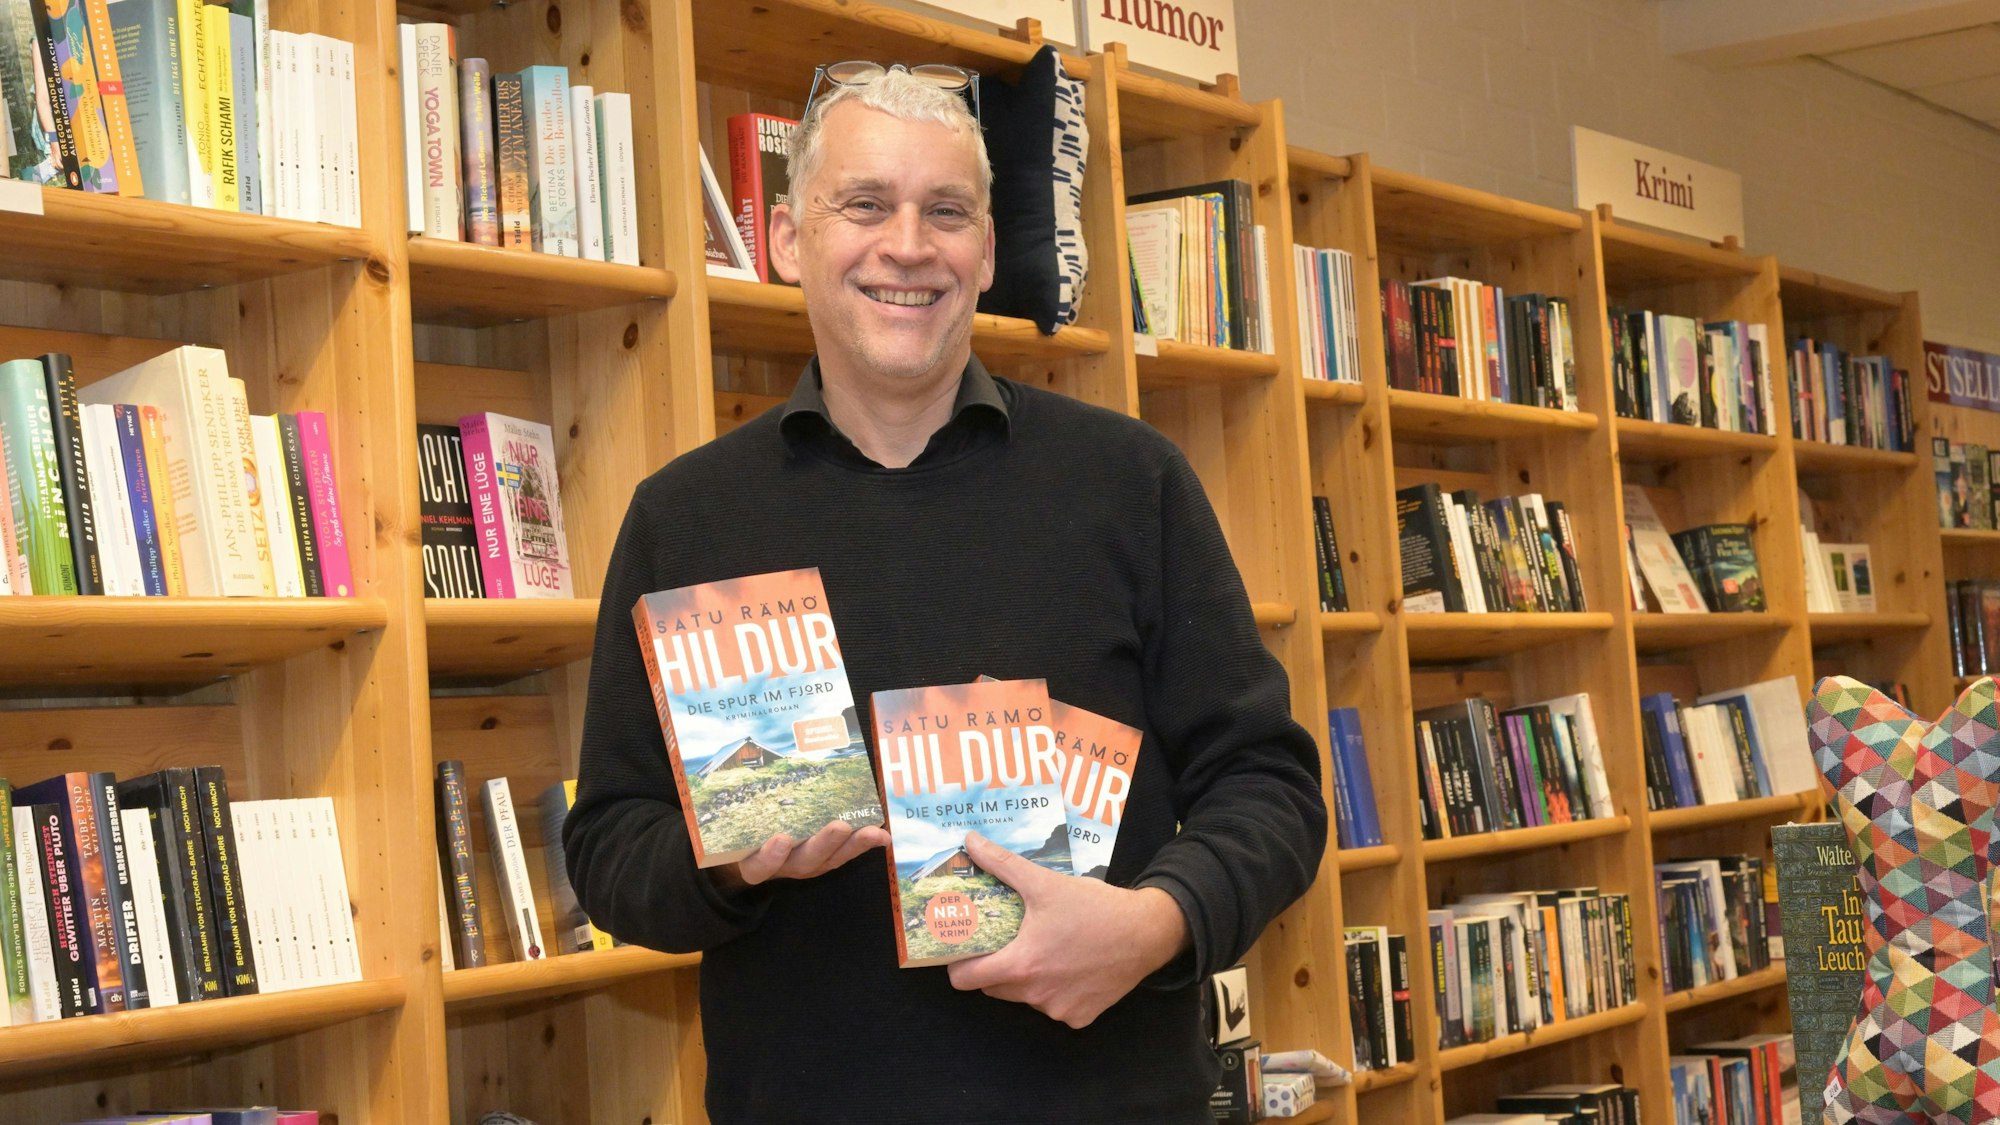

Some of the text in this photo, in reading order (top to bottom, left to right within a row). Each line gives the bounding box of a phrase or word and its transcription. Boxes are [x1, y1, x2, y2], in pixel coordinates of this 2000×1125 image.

[168, 16, 182, 96] DIE TAGE OHNE DICH
[193, 0, 207, 91] ECHTZEITALTE
[417, 38, 430, 75] SPECK
[429, 35, 443, 77] DANIEL
[47, 76, 70, 157] GREGOR SANDER
[48, 37, 78, 156] ALLES RICHTIG GEMACHT
[217, 95, 233, 138] SCHAMI
[509, 80, 522, 132] ANFANG
[196, 120, 206, 158] TONIO
[424, 86, 444, 188] YOGA TOWN
[496, 80, 514, 163] VON HIER BIS
[542, 99, 555, 166] Die Kinder
[553, 74, 567, 166] von Beauvallon
[585, 125, 594, 155] Paradise
[221, 140, 236, 186] RAFIK
[758, 135, 788, 155] ROSE
[244, 175, 252, 203] PIPER
[547, 168, 559, 212] BETTINA
[557, 167, 568, 207] STORKS
[1634, 158, 1695, 210] Krimi
[434, 205, 442, 234] FISCHER
[741, 198, 757, 265] OSENFELDT
[60, 379, 71, 417] BITTE
[126, 415, 135, 437] HEYNE
[231, 396, 250, 454] VOR DER
[504, 423, 540, 440] Malin Stehn
[135, 447, 149, 503] Herzenhören
[198, 367, 242, 560] JAN-PHILIPP SENDKER
[217, 392, 249, 534] DIE BURMA TRILOGIE
[284, 424, 302, 487] SCHICKSAL
[417, 434, 470, 504] ICHT
[508, 440, 539, 467] NUR
[72, 436, 94, 542] DAVID SEDARIS
[308, 449, 326, 506] SHIPMAN
[140, 507, 154, 546] Sendker
[421, 515, 473, 526] NIEL KEHLMAN
[473, 451, 501, 559] NUR EINE LÜGE
[514, 495, 550, 522] EINE
[249, 509, 271, 563] SETZ
[297, 495, 314, 562] ZERUYA SHALEV
[317, 511, 331, 548] VIOLA
[62, 563, 75, 591] DUMONT
[90, 554, 99, 584] BLESSING
[306, 568, 319, 595] PIPER
[523, 562, 560, 590] LÜGE
[655, 595, 818, 634] SATU RÄMÖ
[653, 613, 842, 696] HILDUR
[687, 682, 834, 716] DIE SPUR IM FJORD
[725, 704, 800, 721] KRIMINALROMAN
[884, 707, 1042, 734] SATU RÄMÖ
[879, 725, 1061, 798] HILDUR
[1055, 730, 1129, 766] RÄMÖ
[207, 781, 223, 829] NOCH WACH?
[906, 796, 1049, 819] DIE SPUR IM FJORD
[1444, 771, 1455, 806] FITZEK
[1452, 762, 1466, 808] FITZEK
[1462, 770, 1474, 802] FITZEK
[72, 784, 93, 858] TAUBE UND
[84, 788, 100, 854] WILDENTE
[178, 785, 193, 833] NOCH WACH?
[498, 791, 517, 849] DER PFAU
[839, 808, 871, 821] HEYNE
[941, 816, 1014, 828] KRIMINALROMAN
[105, 785, 129, 885] ULRIKE STERBLICH
[453, 839, 468, 859] DER
[1067, 826, 1101, 845] JORD
[42, 825, 69, 950] HEINRICH STEINFEST
[49, 814, 81, 963] GEWITTER ÜBER PLUTO
[185, 839, 213, 974] BENJAMIN VON STUCKRAD-BARRE
[217, 835, 245, 967] BENJAMIN VON STUCKRAD-BARRE
[456, 872, 479, 938] HEINZ STRUNK
[940, 895, 961, 904] DER
[6, 852, 26, 994] IN EINER DUNKELBLAUEN STUNDE
[89, 897, 107, 948] MARTIN
[101, 888, 117, 956] MOSEBACH
[121, 900, 142, 965] DRIFTER
[934, 904, 969, 919] NR.1
[934, 918, 972, 929] ISLAND
[940, 928, 969, 939] KRIMI
[1817, 945, 1866, 972] Leuch
[74, 978, 83, 1008] PIPER
[111, 993, 123, 1004] dtv
